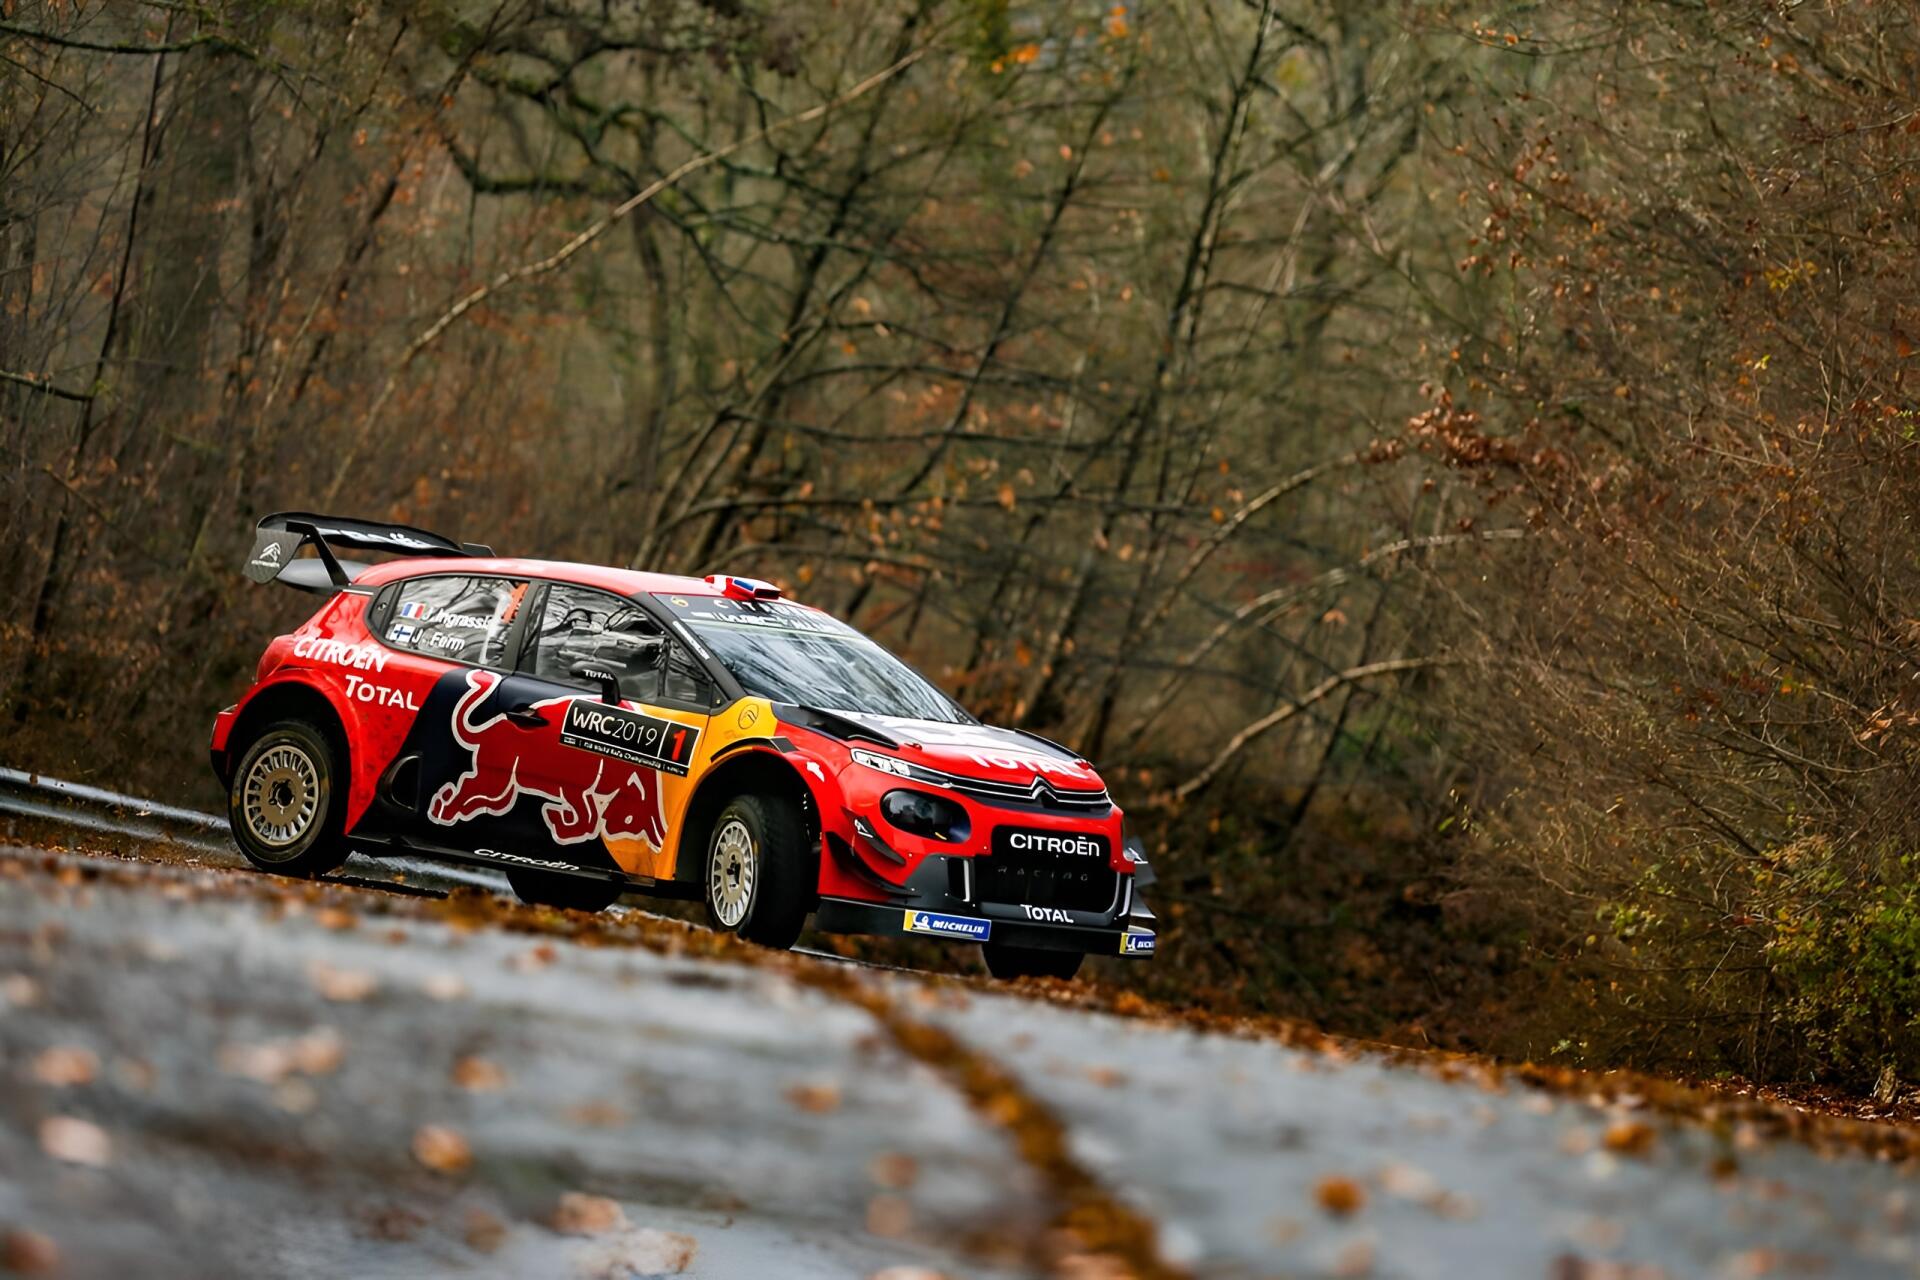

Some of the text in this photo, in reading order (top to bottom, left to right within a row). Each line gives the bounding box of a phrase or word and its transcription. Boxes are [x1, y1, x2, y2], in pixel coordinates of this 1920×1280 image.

[345, 674, 419, 711] TOTAL
[672, 730, 687, 761] 1
[1020, 904, 1074, 923] TOTAL
[932, 920, 984, 934] MICHELIN
